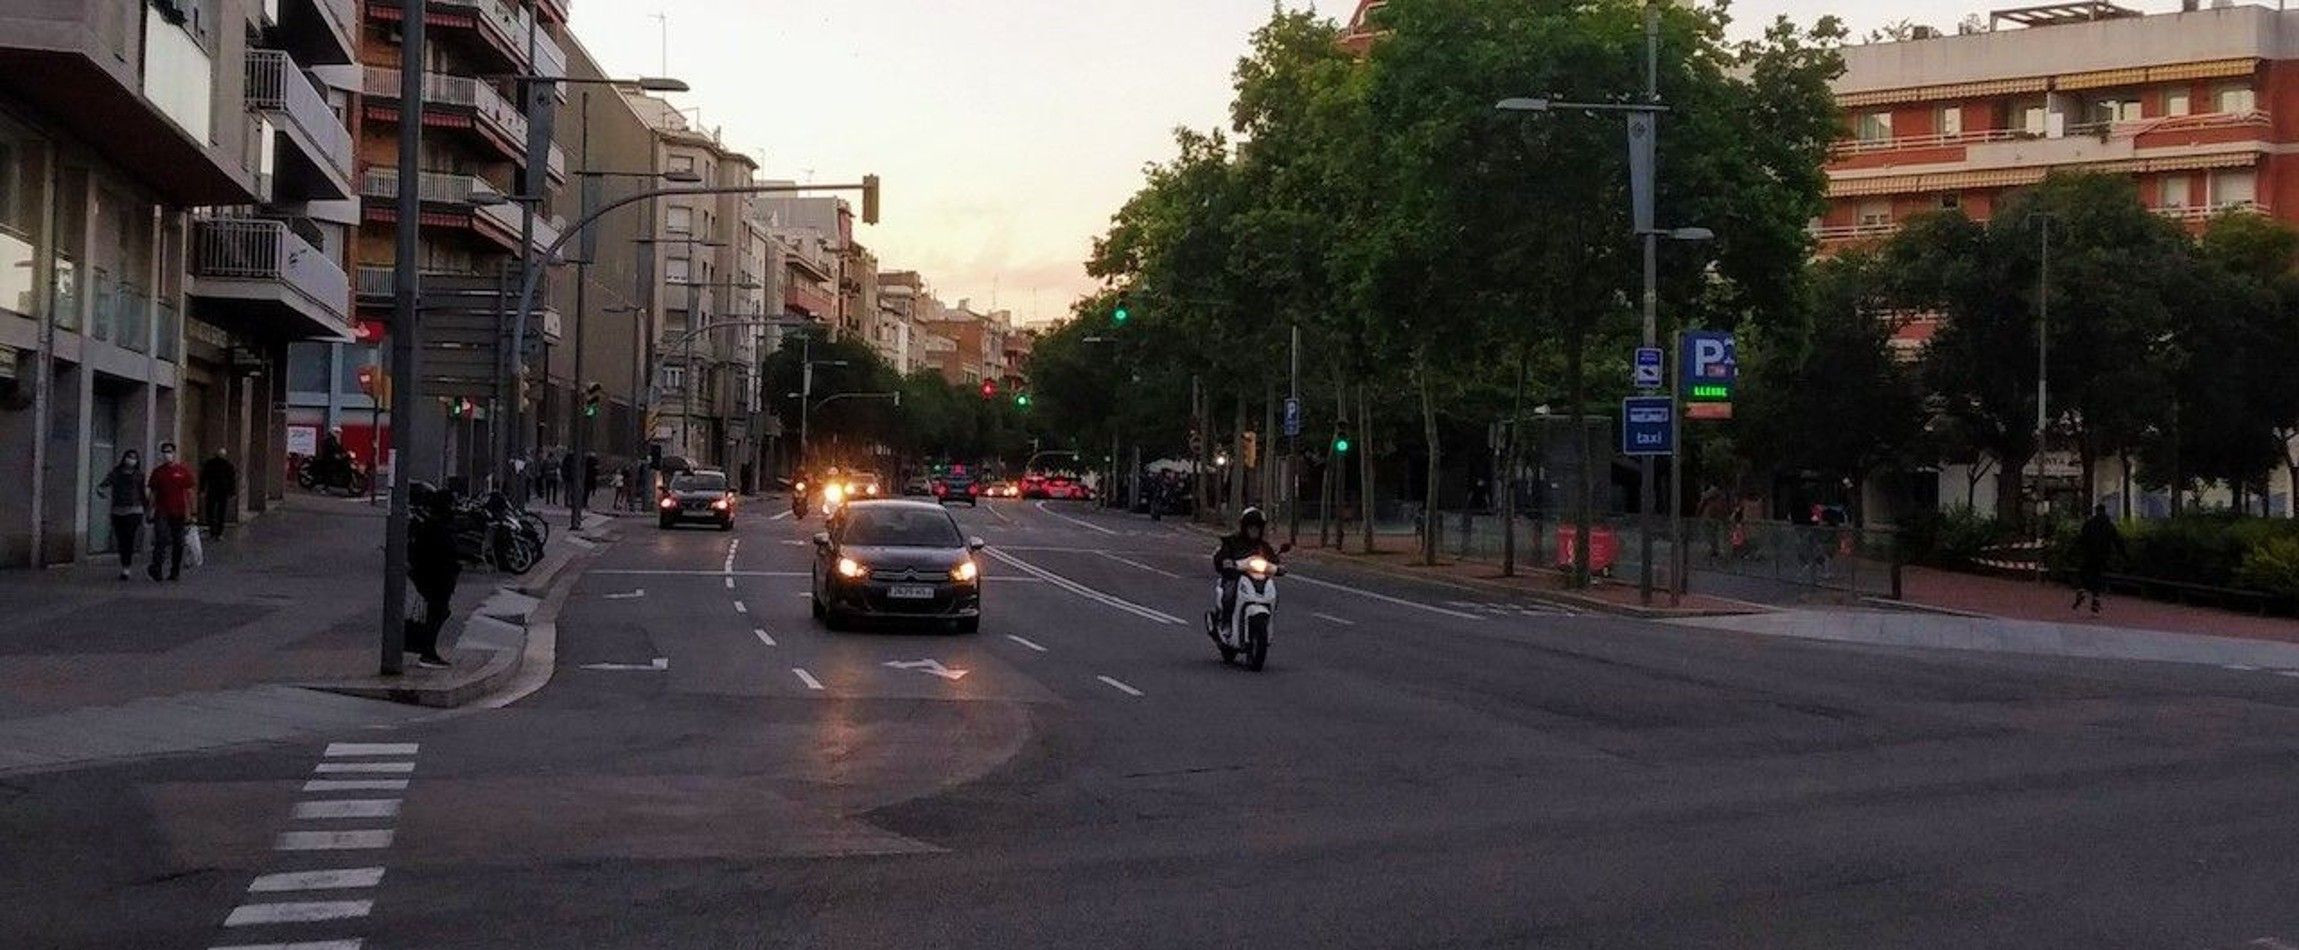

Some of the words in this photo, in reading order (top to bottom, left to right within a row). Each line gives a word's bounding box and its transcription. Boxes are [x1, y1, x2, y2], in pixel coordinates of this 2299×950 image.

[1695, 339, 1725, 377] P
[1287, 401, 1296, 419] P
[1637, 431, 1662, 444] taxi
